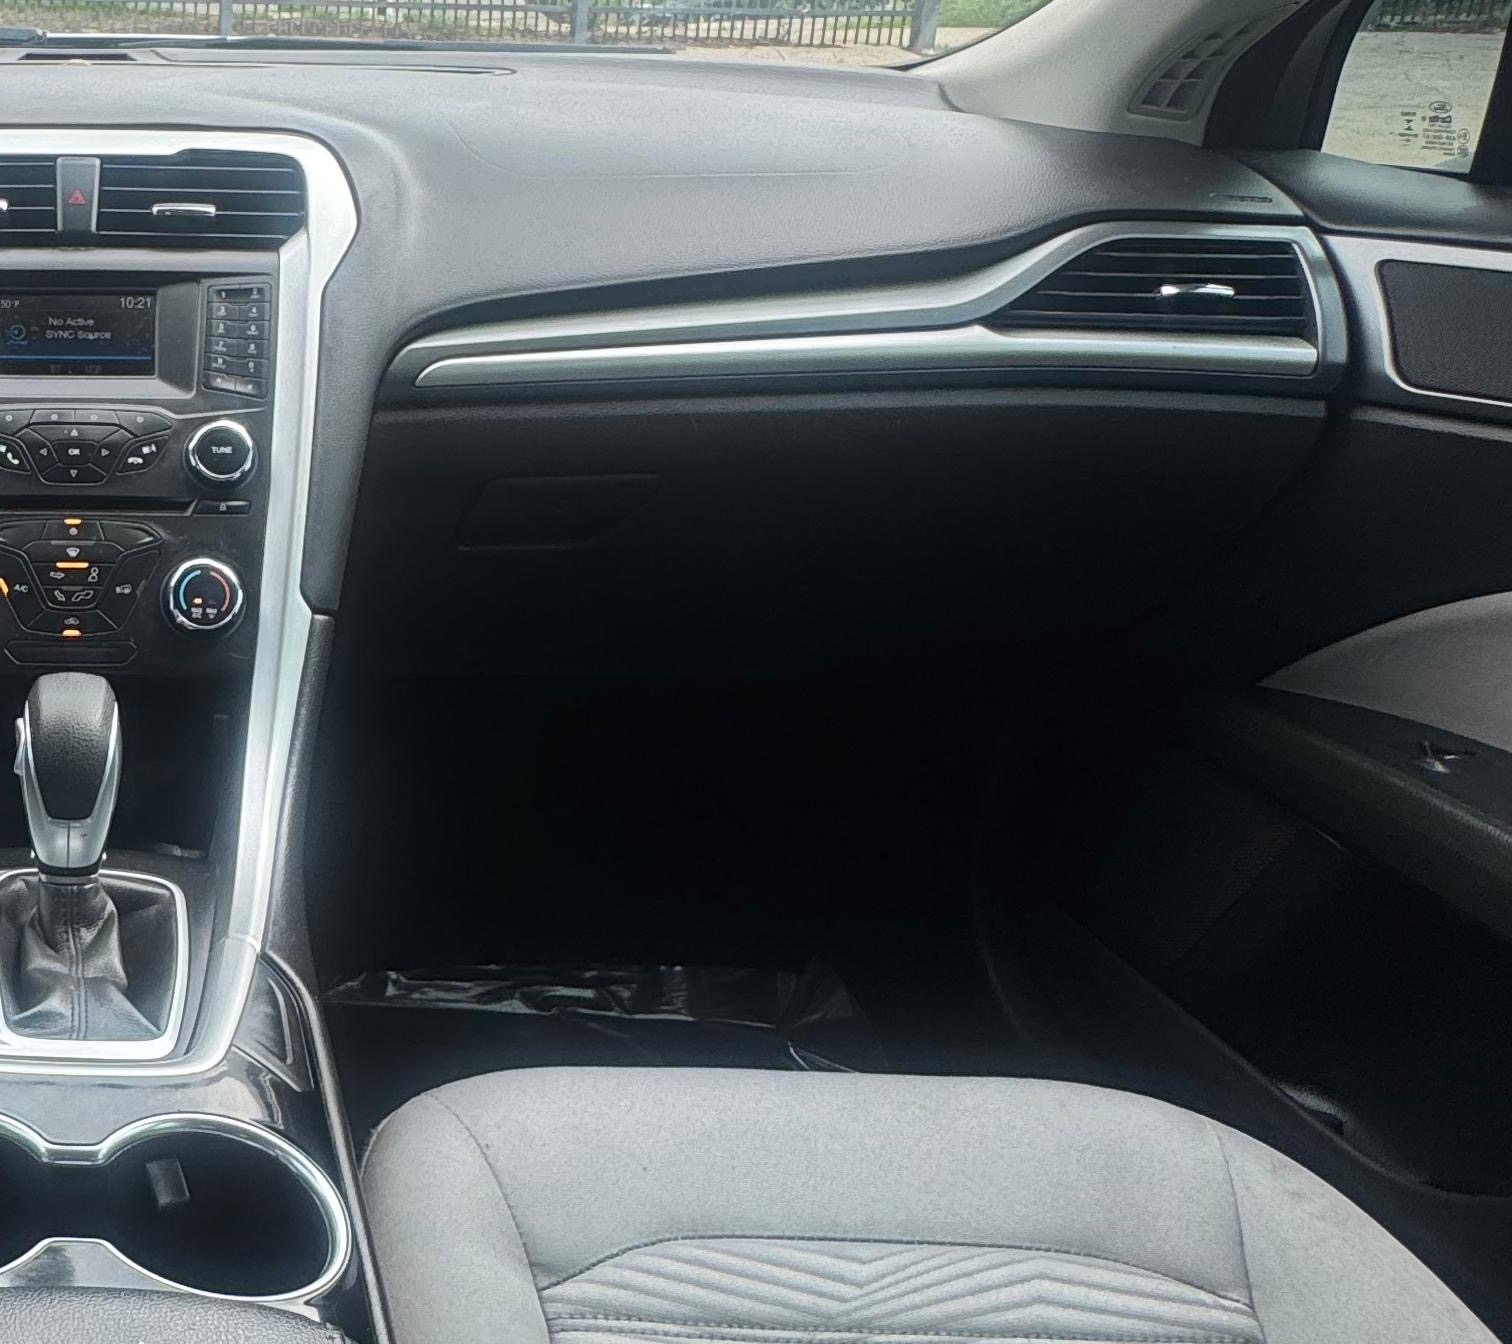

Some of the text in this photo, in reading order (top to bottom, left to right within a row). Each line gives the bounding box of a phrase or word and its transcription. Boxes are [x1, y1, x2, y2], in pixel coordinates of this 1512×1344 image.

[119, 296, 152, 309] 10:21
[48, 317, 95, 326] No Active
[45, 330, 112, 339] SYNC Source
[68, 448, 81, 456] OK
[210, 446, 233, 454] TUNE
[14, 583, 29, 593] A/C
